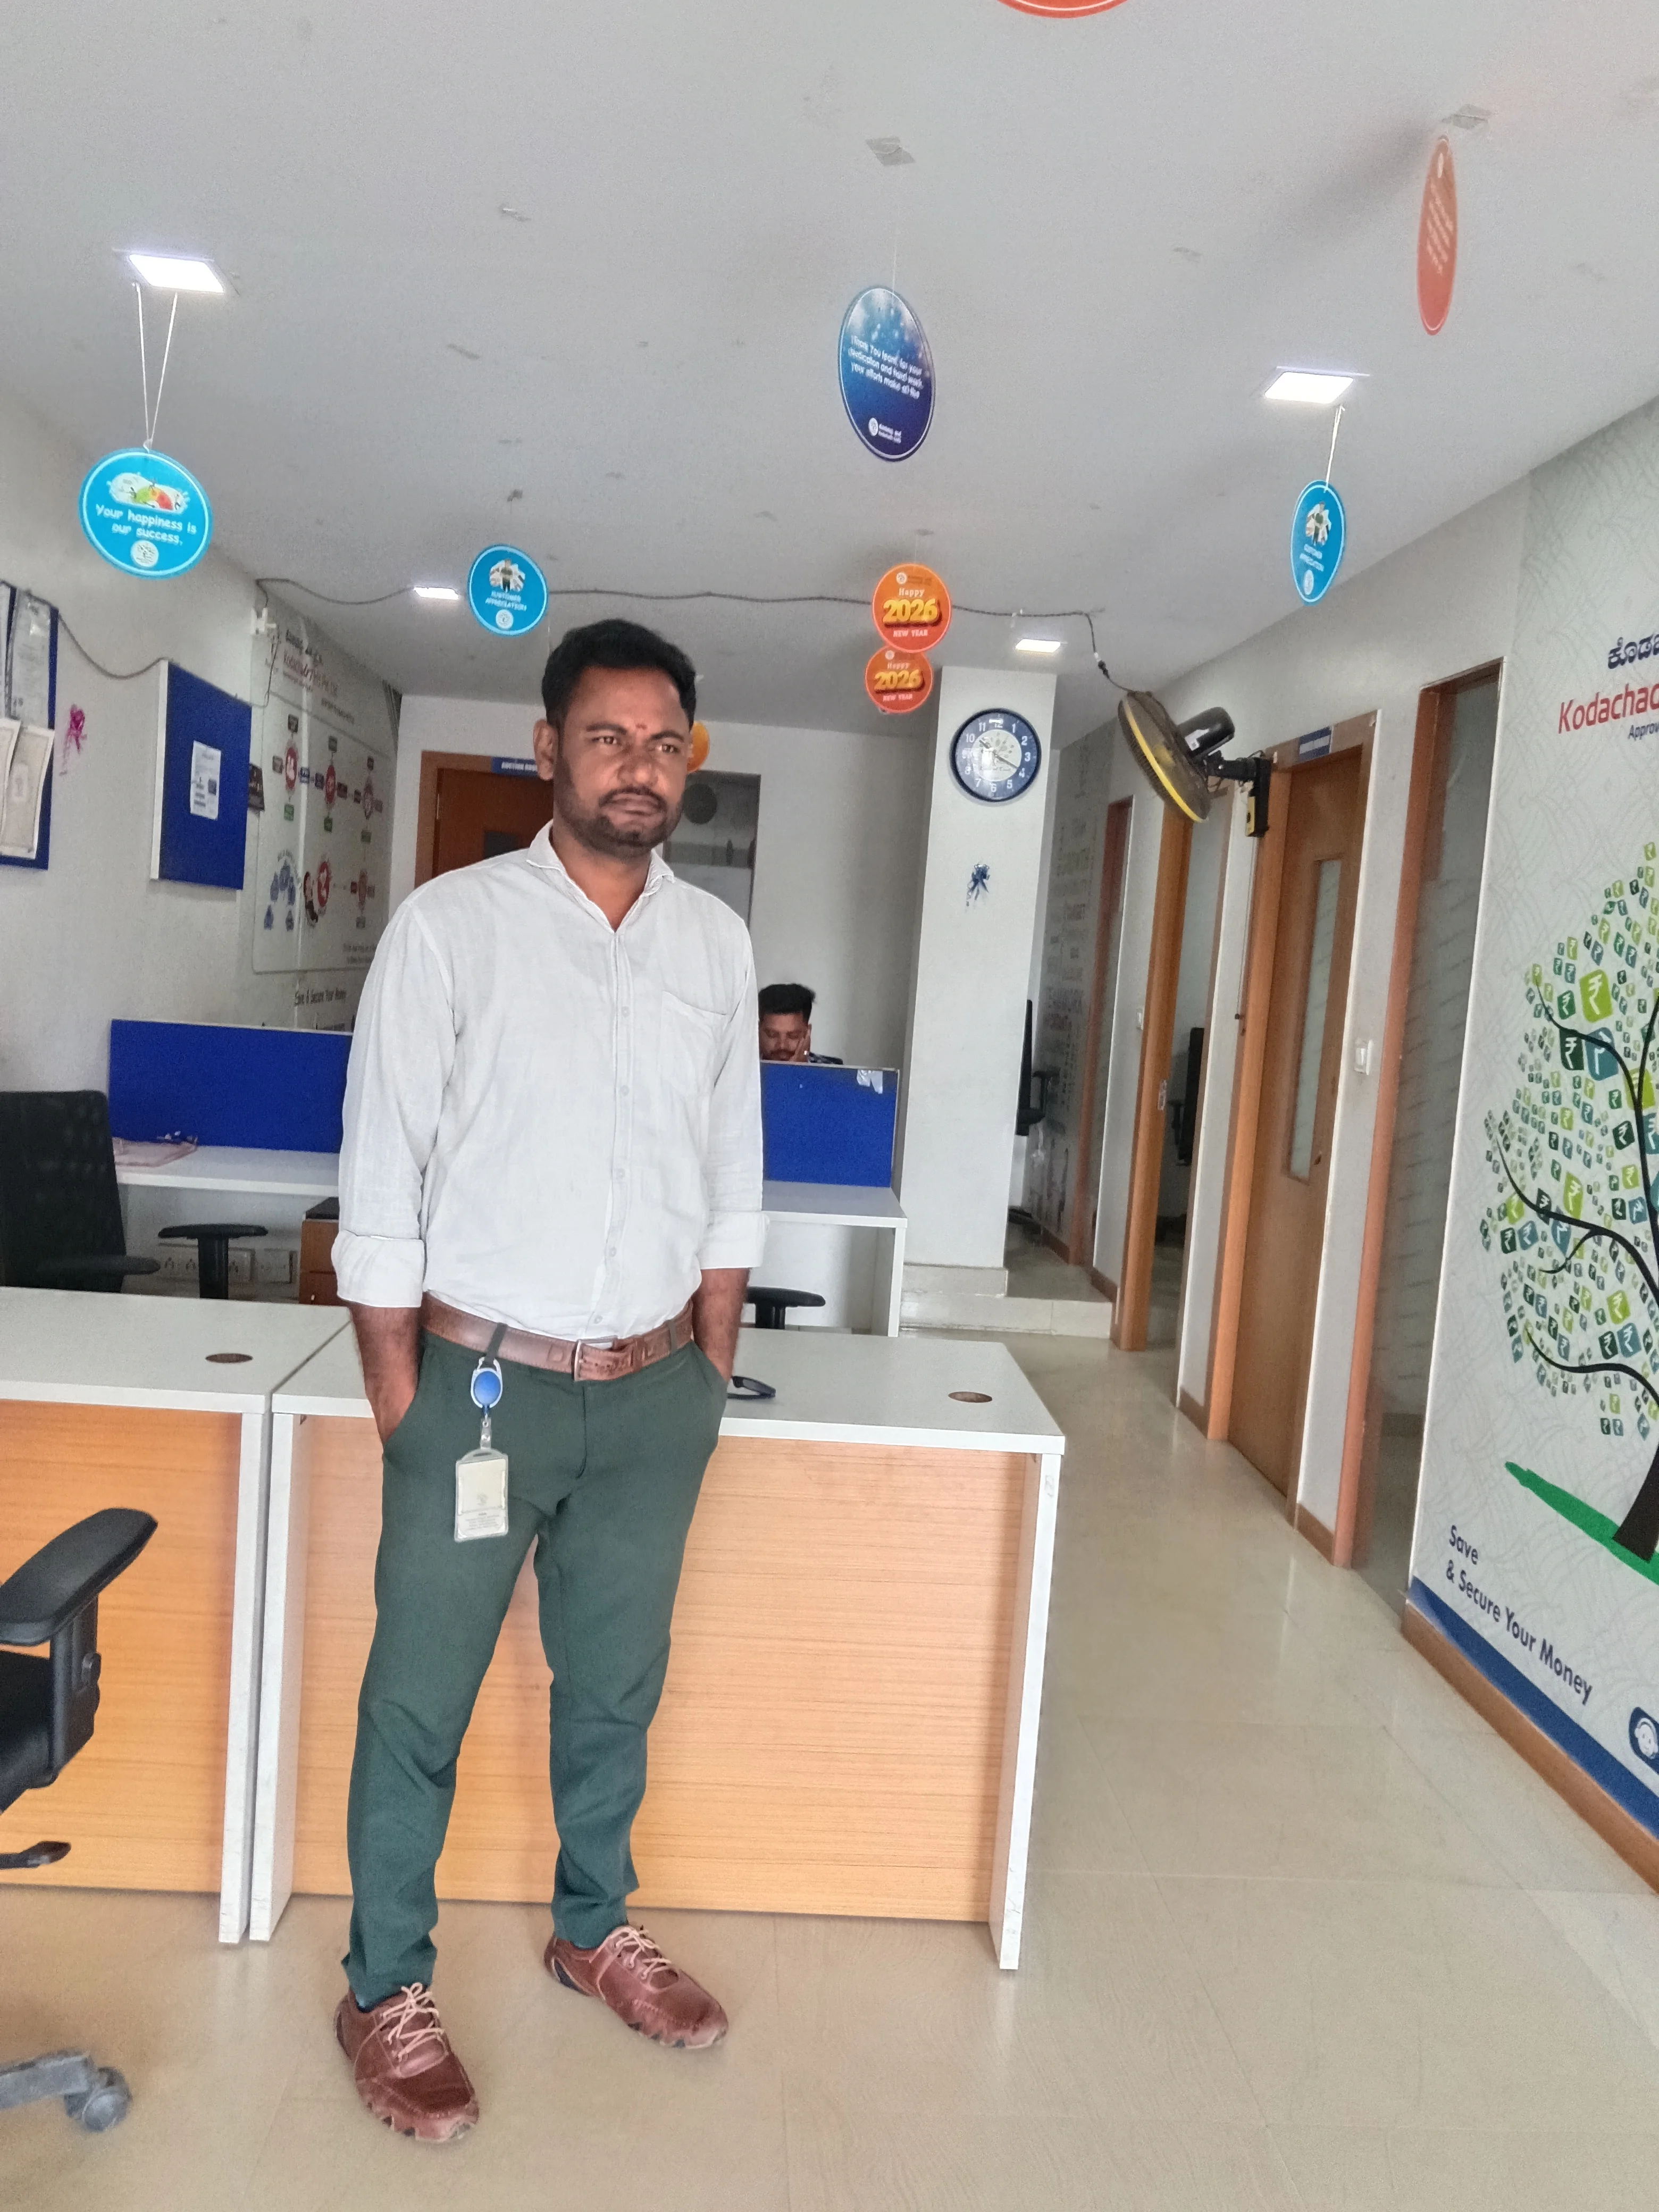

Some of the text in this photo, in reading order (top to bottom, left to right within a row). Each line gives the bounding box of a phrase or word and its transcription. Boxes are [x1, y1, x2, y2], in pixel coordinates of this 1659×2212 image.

[870, 345, 881, 358] You
[881, 364, 893, 375] and
[884, 377, 901, 391] make
[96, 504, 197, 534] Your happiness is
[112, 523, 131, 535] our
[898, 588, 925, 597] Happy
[882, 598, 940, 624] 2026
[874, 669, 923, 691] 2026
[978, 722, 986, 732] 11
[1012, 724, 1016, 733] 1
[966, 733, 975, 743] 10
[1021, 736, 1028, 745] 2
[1024, 752, 1031, 762] 3
[1019, 768, 1025, 778] 4
[975, 778, 982, 787] 7
[991, 783, 997, 792] 6
[1007, 780, 1013, 789] 5
[1448, 1524, 1479, 1565] Save
[1445, 1560, 1594, 1706] & Secure Your Money
